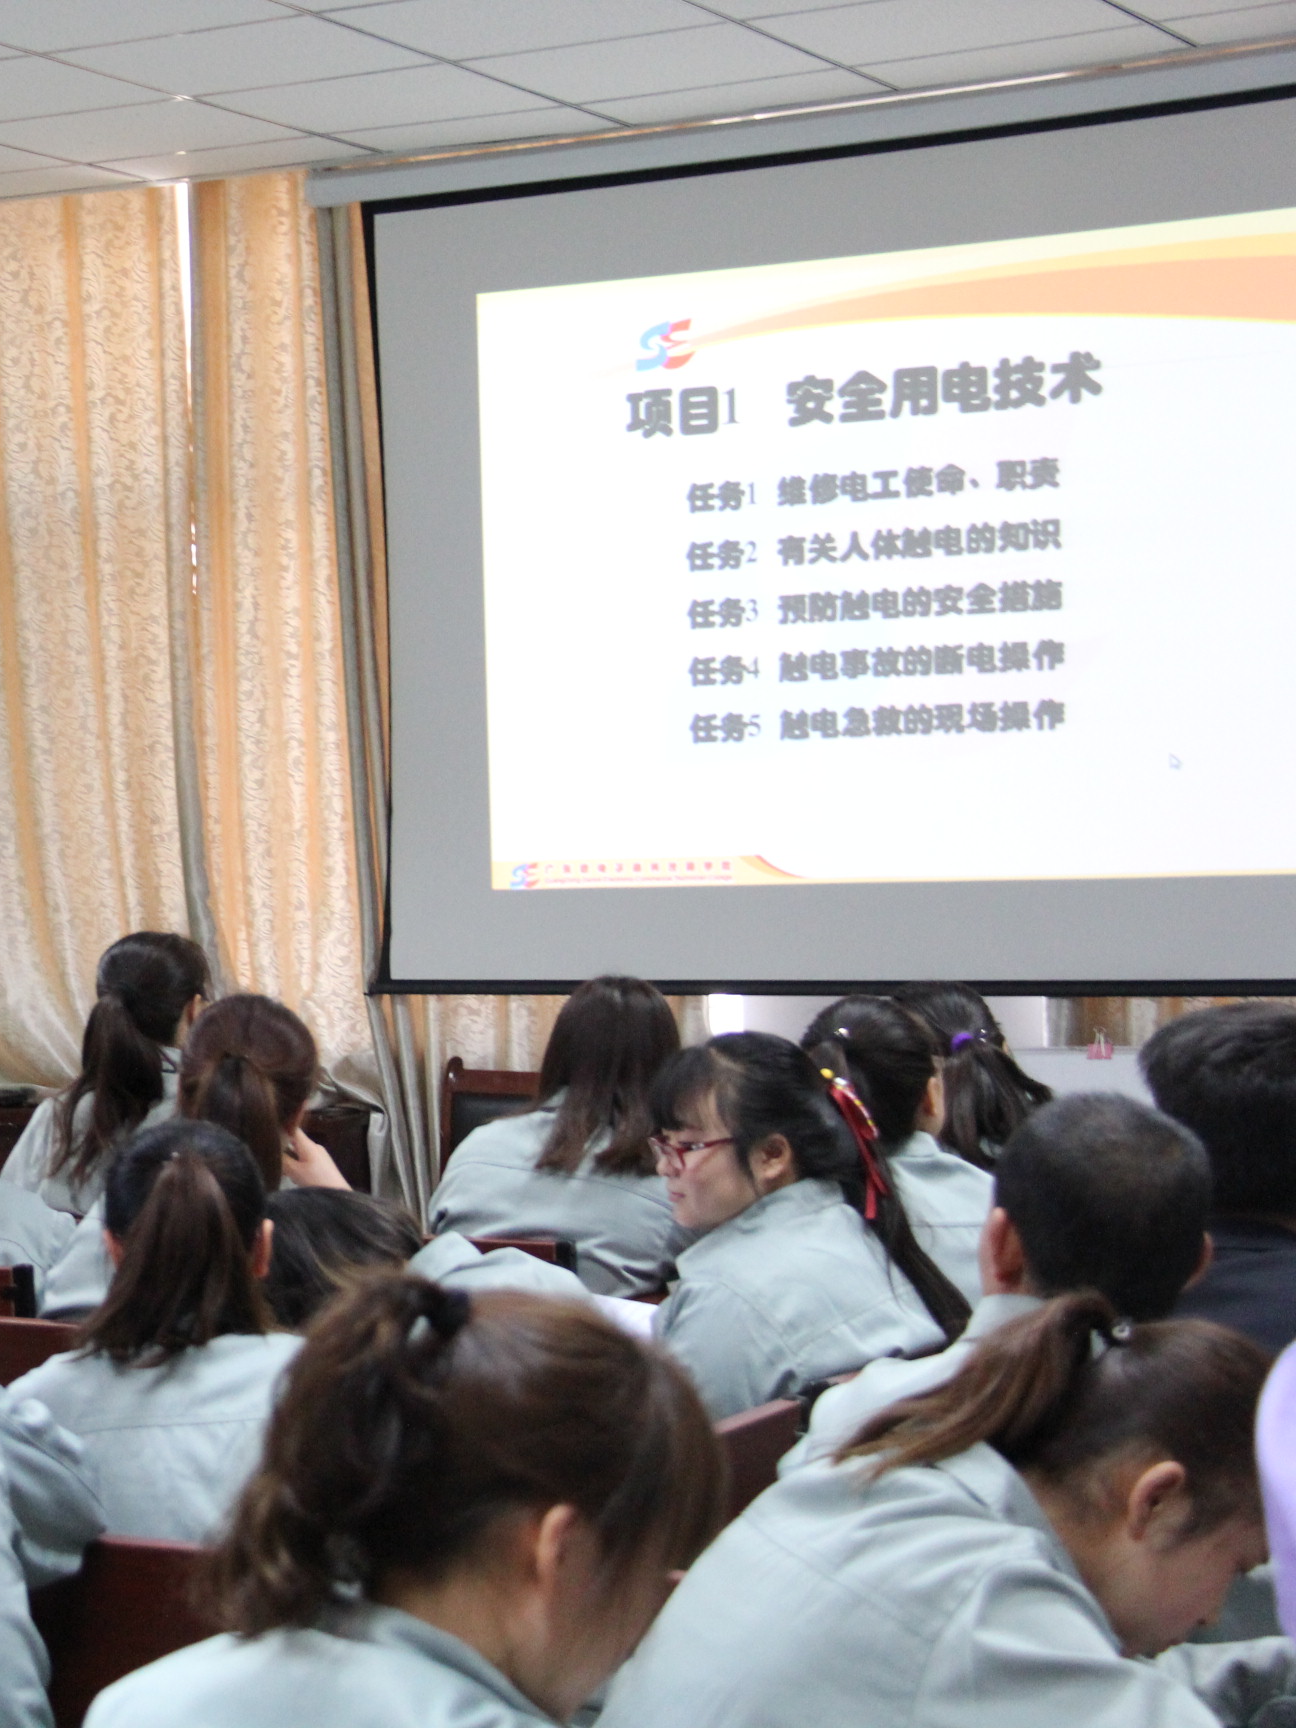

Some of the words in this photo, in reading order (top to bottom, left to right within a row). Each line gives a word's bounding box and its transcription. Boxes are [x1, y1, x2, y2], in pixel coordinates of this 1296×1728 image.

[626, 385, 740, 438] 项目1
[786, 351, 1103, 427] 安全用电技术
[686, 481, 757, 513] 任务1
[686, 540, 758, 572] 任务2
[777, 518, 1062, 566] 有关人体触电的知识
[687, 598, 759, 629] 任务3
[778, 579, 1063, 624] 预防触电的安全措施
[688, 655, 760, 687] 任务4
[779, 639, 1065, 682] 触电事故的断电操作
[690, 712, 761, 744] 任务5
[780, 699, 1065, 740] 触电急救的现场操作
